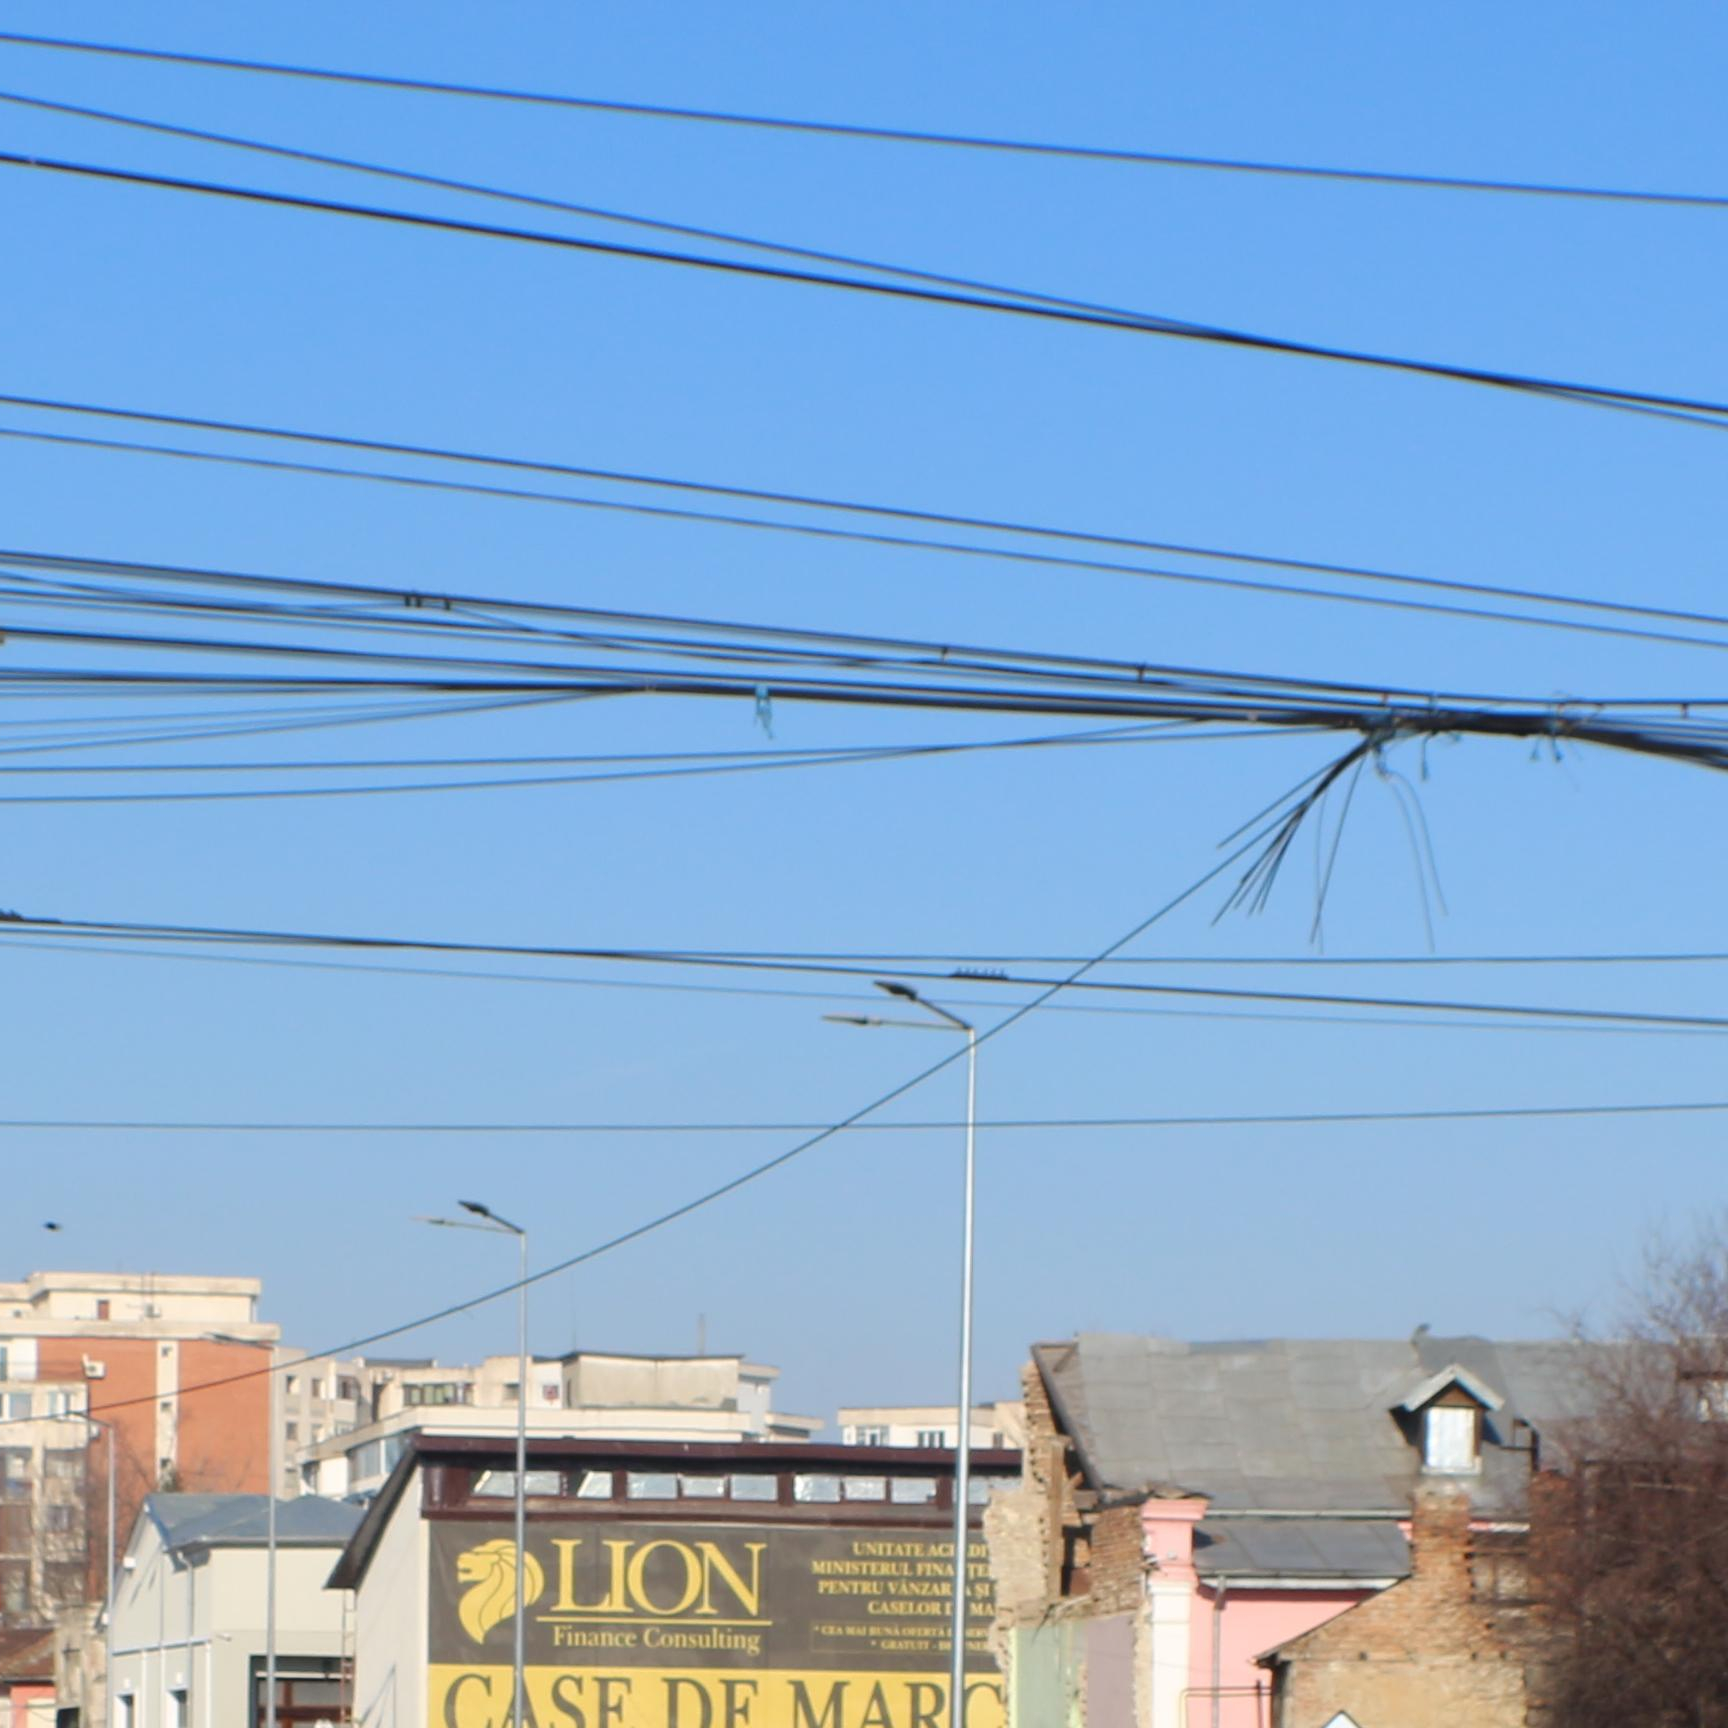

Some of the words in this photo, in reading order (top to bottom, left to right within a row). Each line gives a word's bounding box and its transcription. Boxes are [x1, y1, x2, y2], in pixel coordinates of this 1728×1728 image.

[852, 1541, 924, 1557] UNITATE
[811, 1560, 913, 1576] MINISTERUL
[550, 1538, 768, 1616] LION
[818, 1579, 884, 1596] PENTRU
[867, 1600, 941, 1616] CASELOR
[553, 1625, 637, 1649] Finance
[642, 1626, 762, 1656] Consulting
